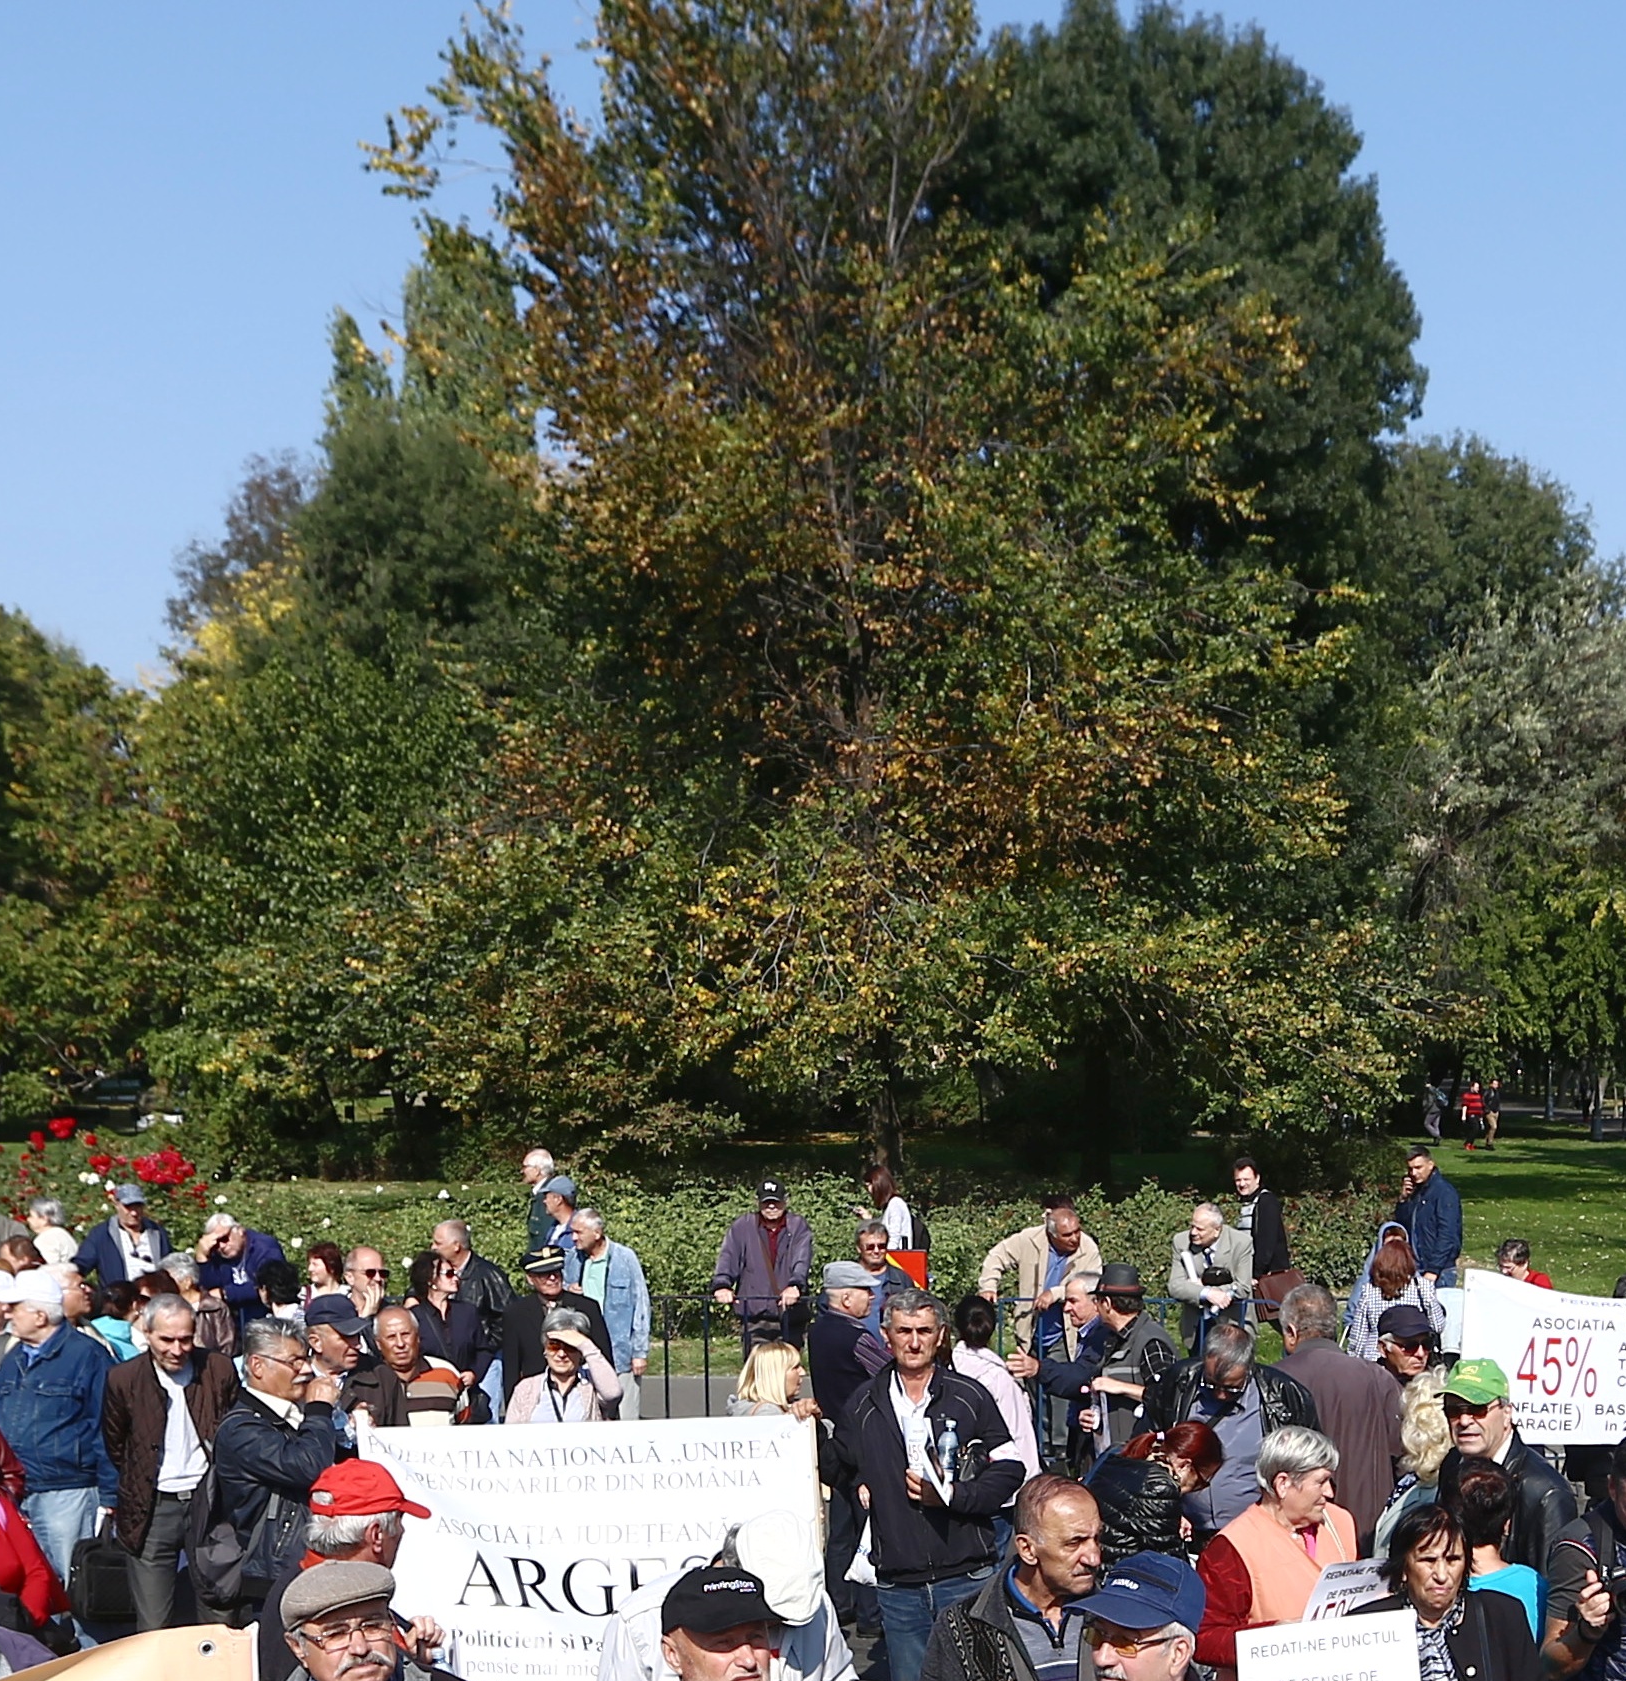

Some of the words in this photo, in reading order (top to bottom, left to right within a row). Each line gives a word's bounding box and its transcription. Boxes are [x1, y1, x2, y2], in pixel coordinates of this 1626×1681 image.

[1532, 1317, 1616, 1332] ASOCIATIA
[1516, 1336, 1598, 1398] 45%
[1511, 1401, 1573, 1416] NFLATIE
[1516, 1417, 1574, 1432] ARACIE
[605, 1471, 646, 1493] DIN
[651, 1466, 763, 1491] ROMÂNIA
[1326, 1590, 1338, 1601] DE
[1338, 1584, 1366, 1598] PENSIE
[450, 1628, 553, 1650] Politicieni
[1250, 1636, 1327, 1660] REDATI-NE
[1331, 1629, 1401, 1650] PUNCTUL
[465, 1656, 520, 1677] pensie
[525, 1658, 559, 1676] mai
